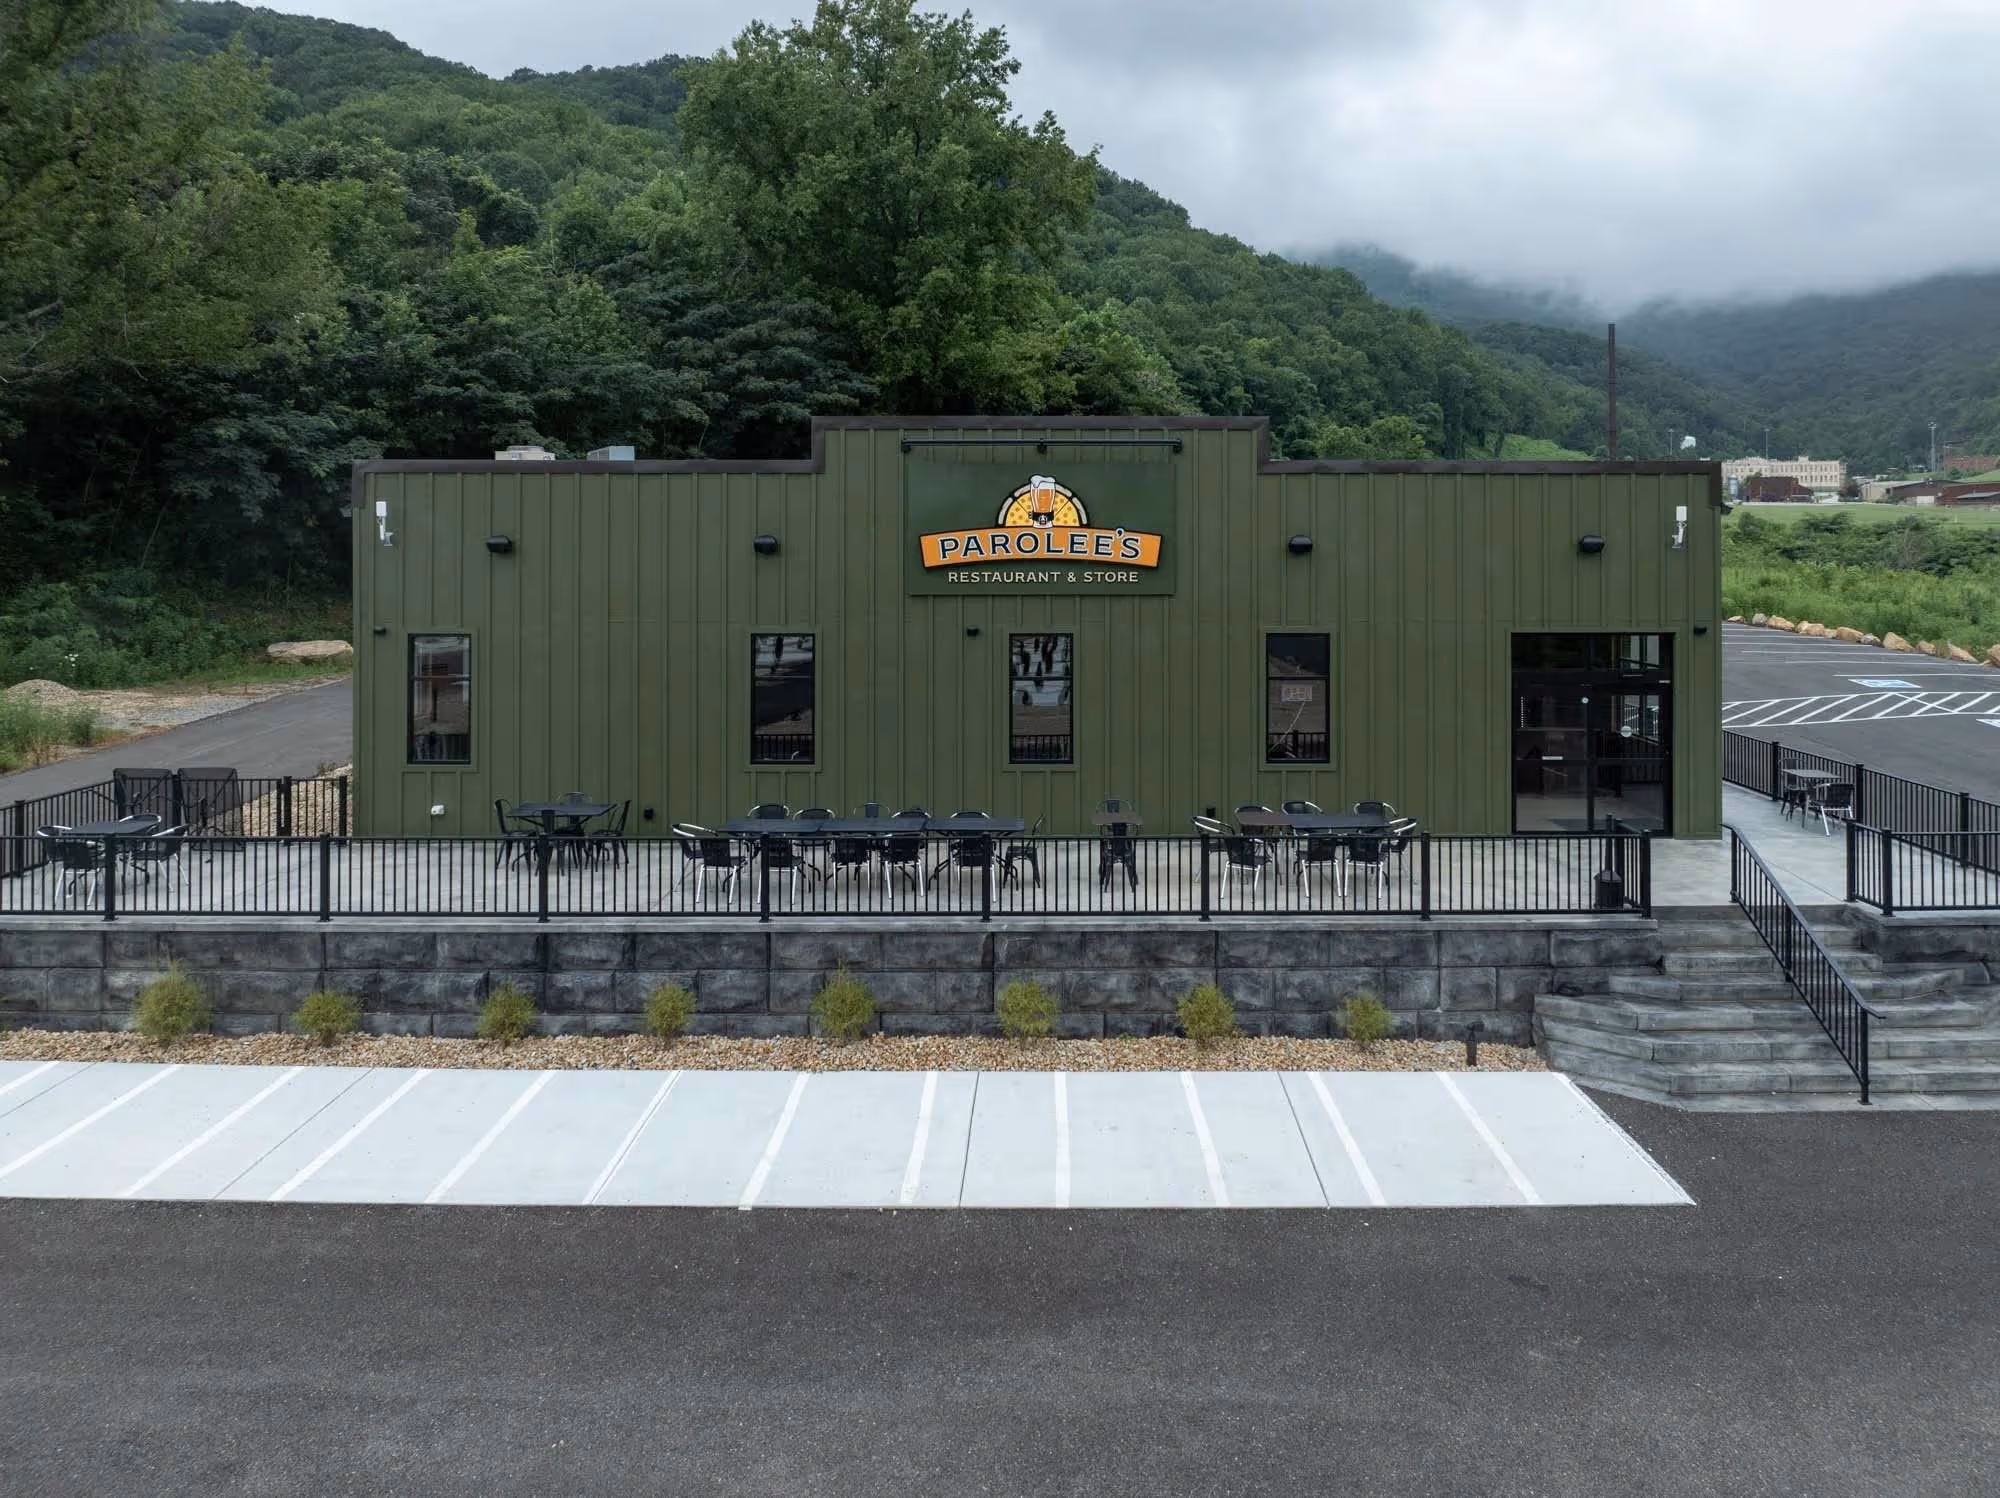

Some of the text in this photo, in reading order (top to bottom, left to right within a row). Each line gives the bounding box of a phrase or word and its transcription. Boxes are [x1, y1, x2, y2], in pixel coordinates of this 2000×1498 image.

[939, 528, 1141, 560] PAROLEE'S
[947, 571, 1139, 583] RESTAURANT & STORE
